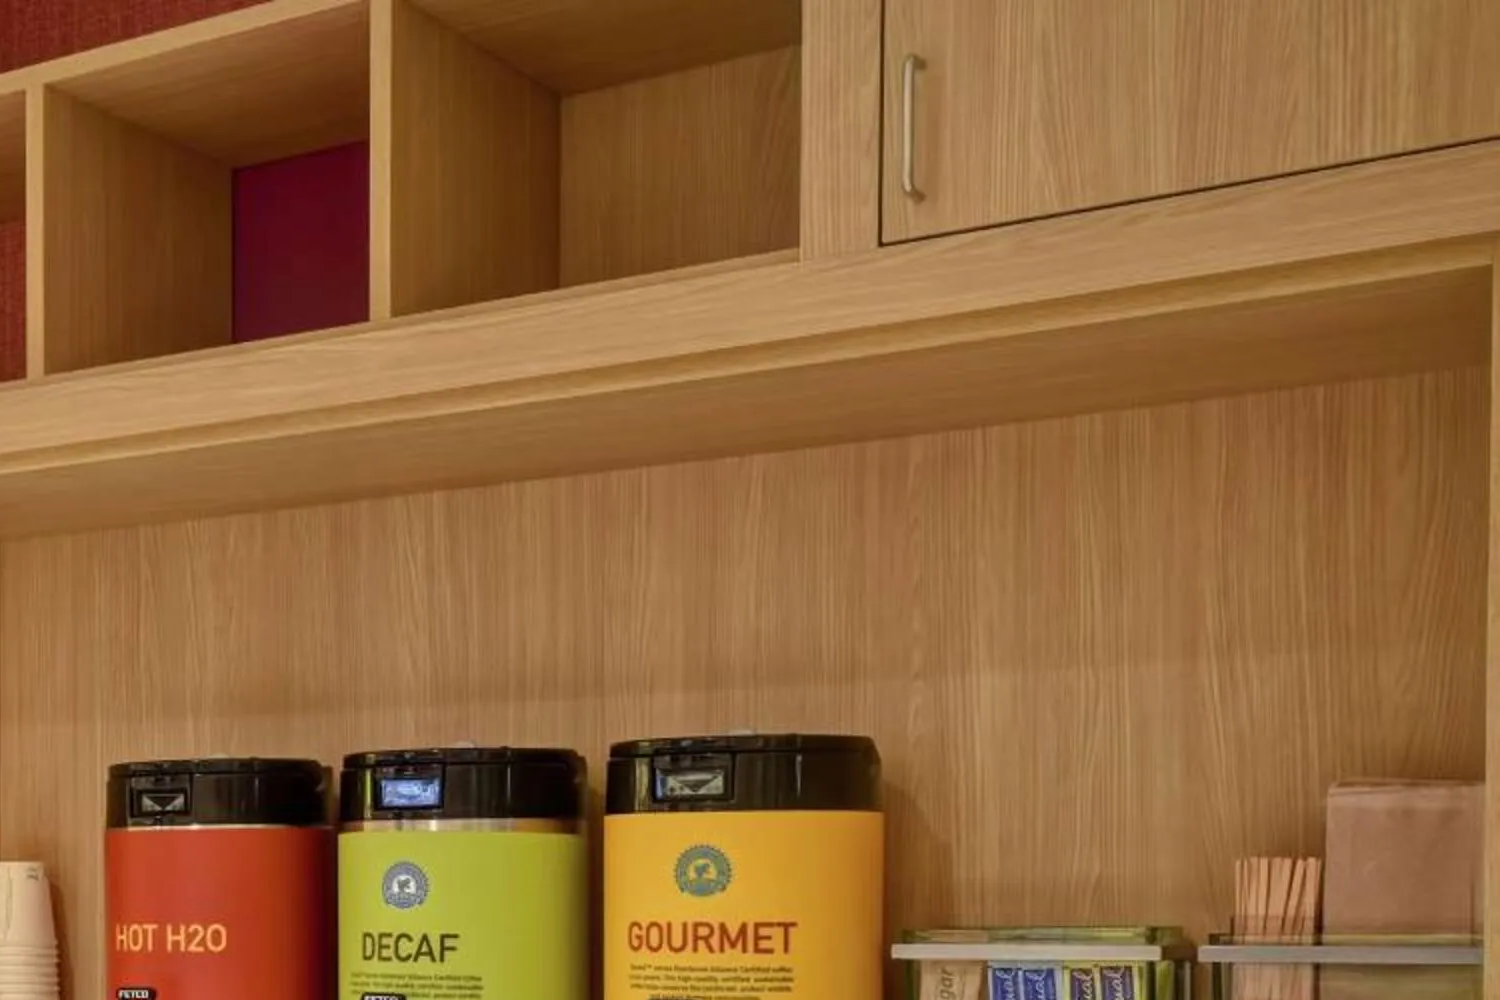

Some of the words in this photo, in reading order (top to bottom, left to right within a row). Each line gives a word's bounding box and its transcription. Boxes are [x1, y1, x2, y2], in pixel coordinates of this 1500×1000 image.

[116, 923, 158, 952] HOT
[166, 923, 227, 952] H2O
[362, 932, 460, 964] DECAF
[627, 921, 798, 955] GOURMET
